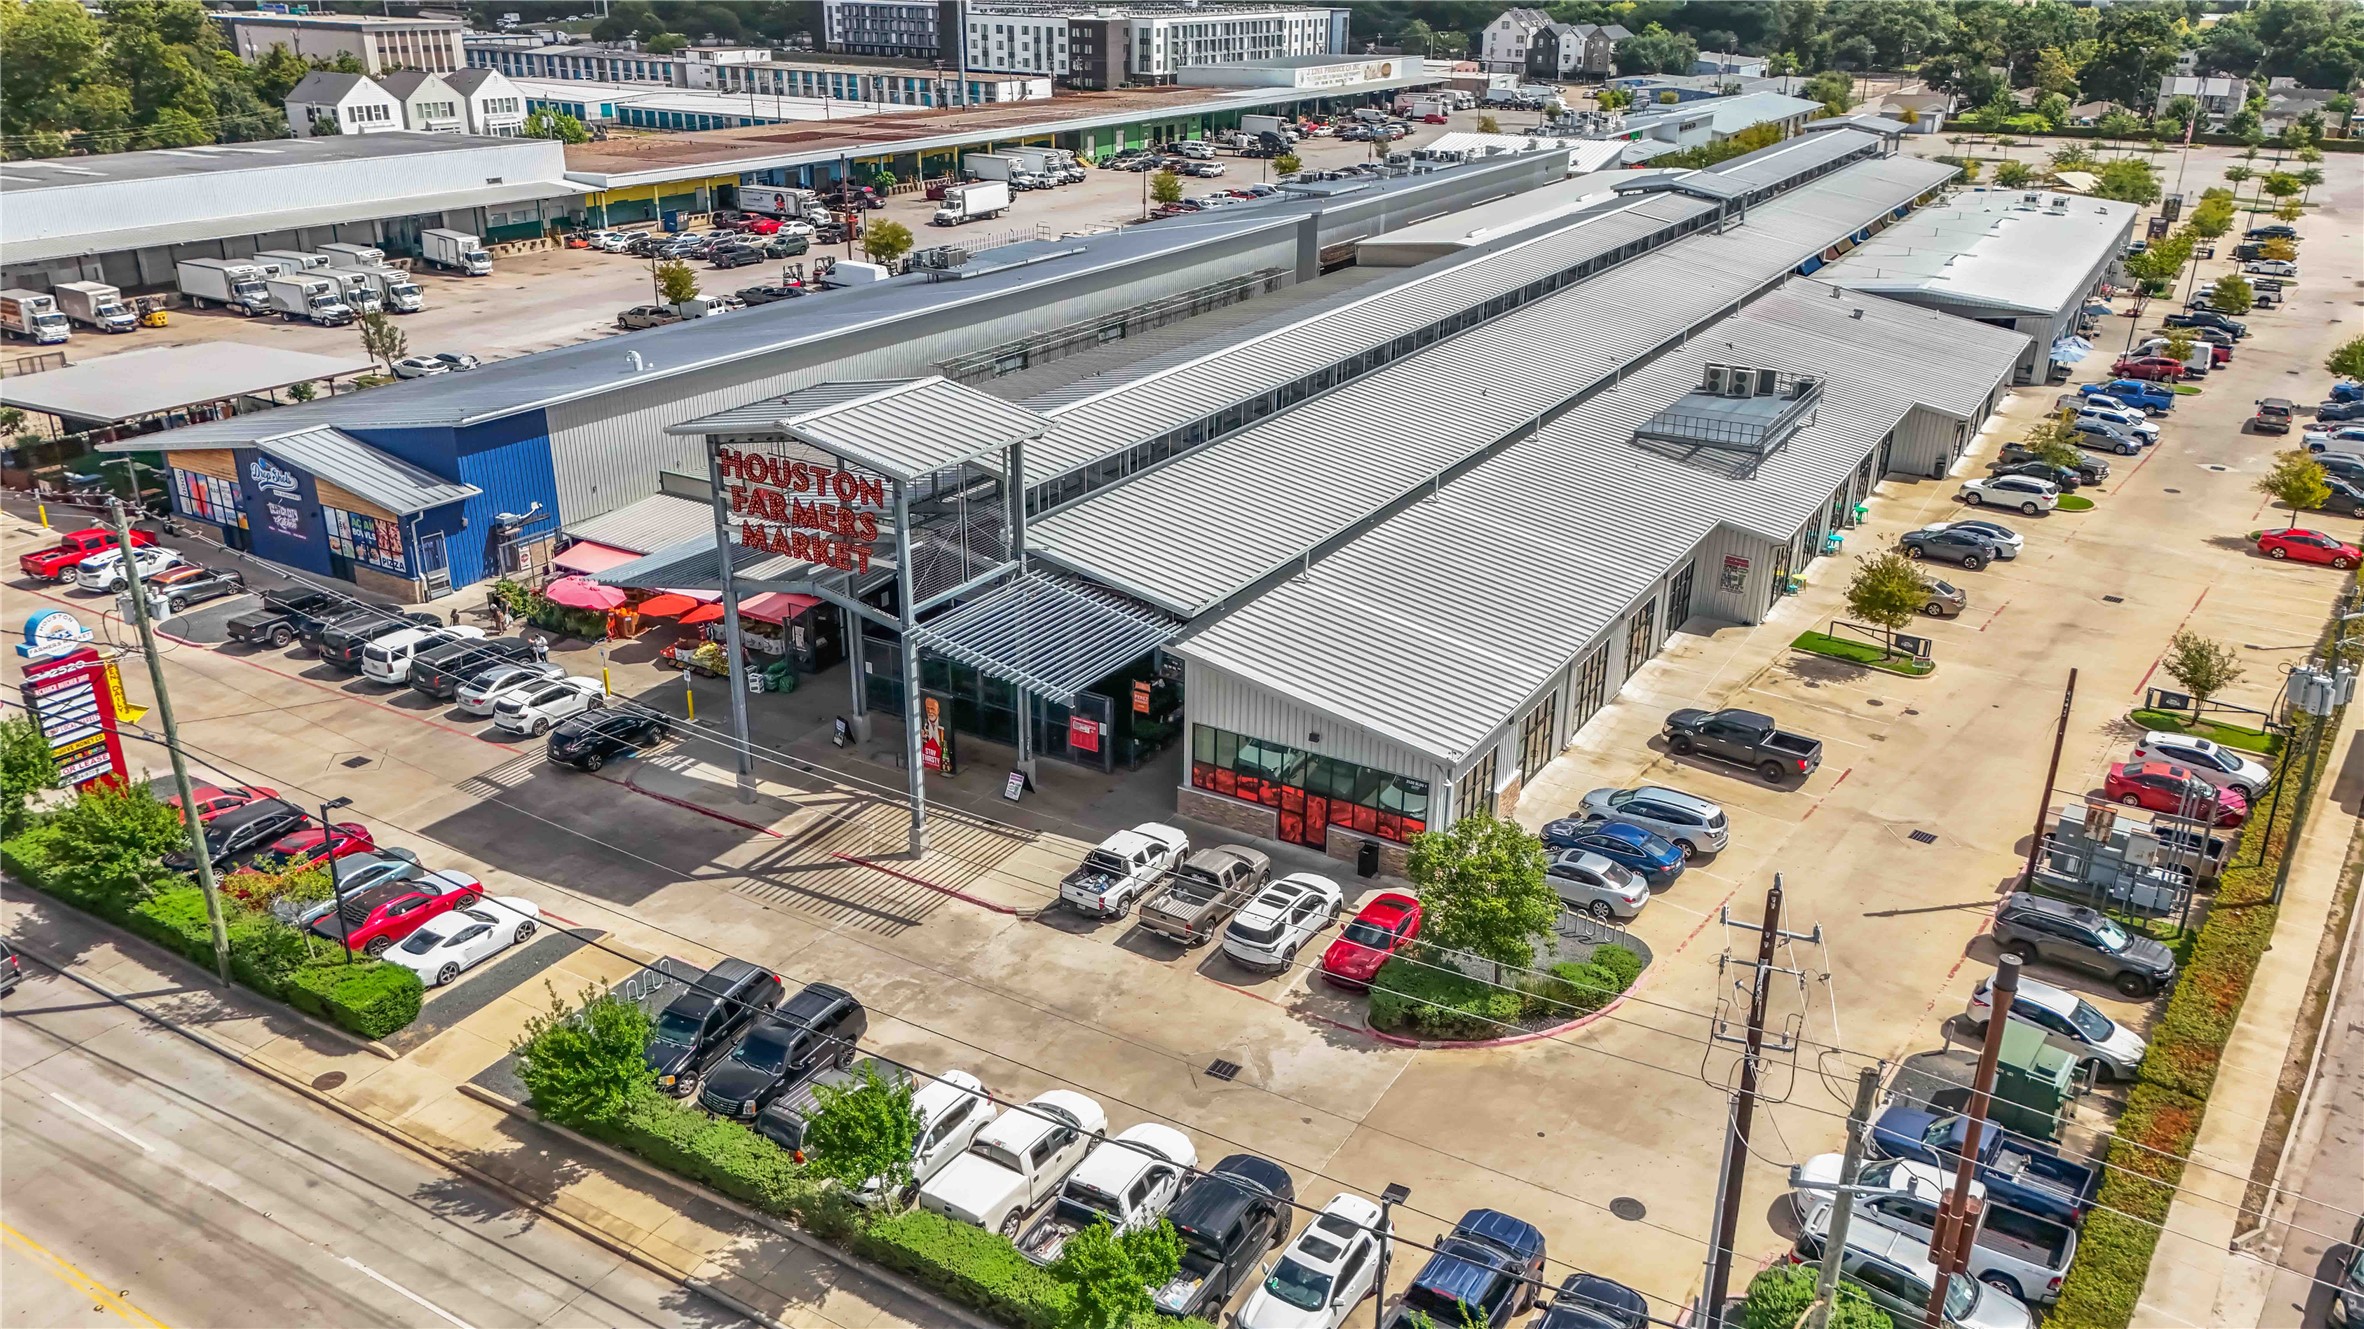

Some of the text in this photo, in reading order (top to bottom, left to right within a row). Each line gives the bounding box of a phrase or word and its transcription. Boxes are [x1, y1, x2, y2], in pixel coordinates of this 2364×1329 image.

[720, 448, 884, 509] HOUSTON
[730, 484, 878, 542] FARMERS
[742, 519, 873, 575] MARKET
[382, 557, 405, 571] PIZZA
[39, 613, 74, 632] HOUSTON
[28, 641, 62, 655] FARMERS
[50, 660, 86, 678] 2520
[112, 685, 124, 713] DAILY
[75, 737, 95, 748] HONEY
[79, 753, 109, 769] LEASE
